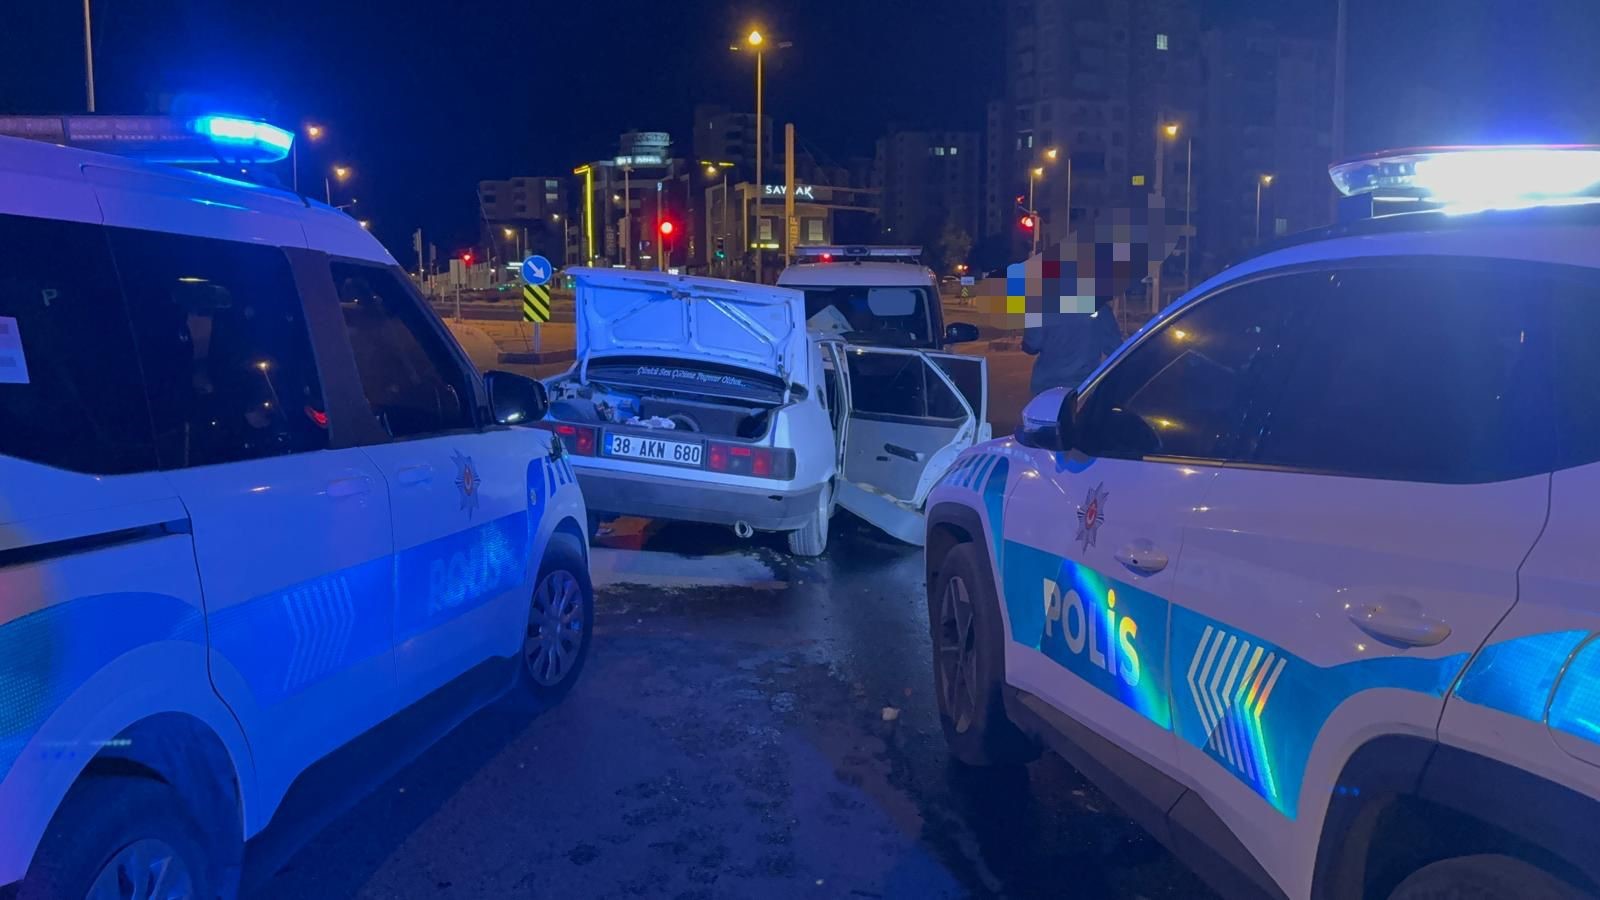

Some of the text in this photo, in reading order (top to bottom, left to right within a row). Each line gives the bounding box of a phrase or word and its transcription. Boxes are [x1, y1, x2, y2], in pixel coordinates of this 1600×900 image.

[766, 185, 814, 199] SAYAK
[613, 437, 700, 462] 38 AKN 680
